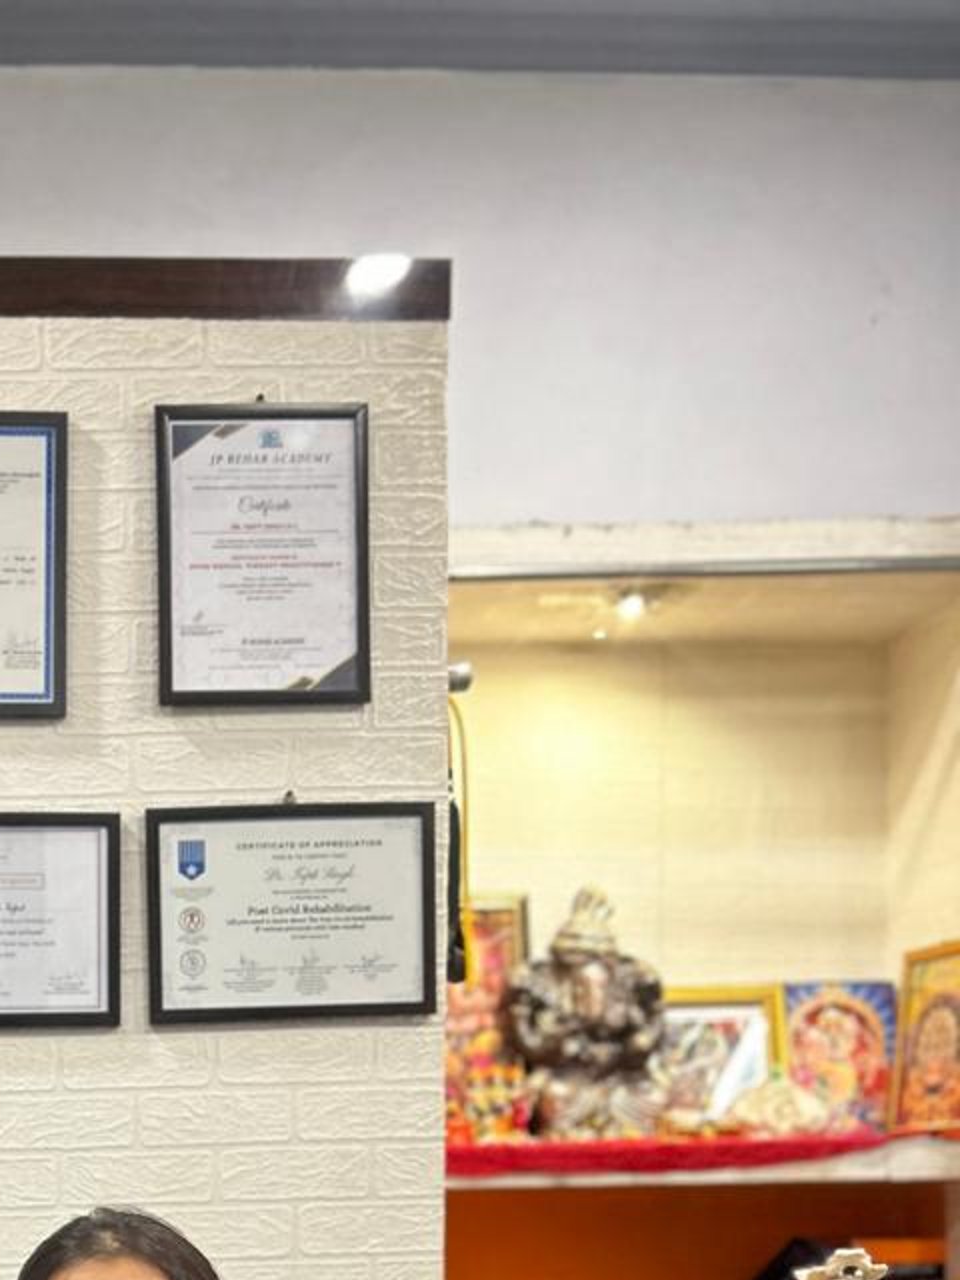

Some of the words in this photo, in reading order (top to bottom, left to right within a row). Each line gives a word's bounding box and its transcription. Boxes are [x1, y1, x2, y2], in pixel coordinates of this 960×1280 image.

[272, 453, 333, 464] ACADEMY
[236, 841, 296, 850] CERTIFICATE
[299, 840, 311, 848] OF
[313, 839, 383, 848] APPRECIATION
